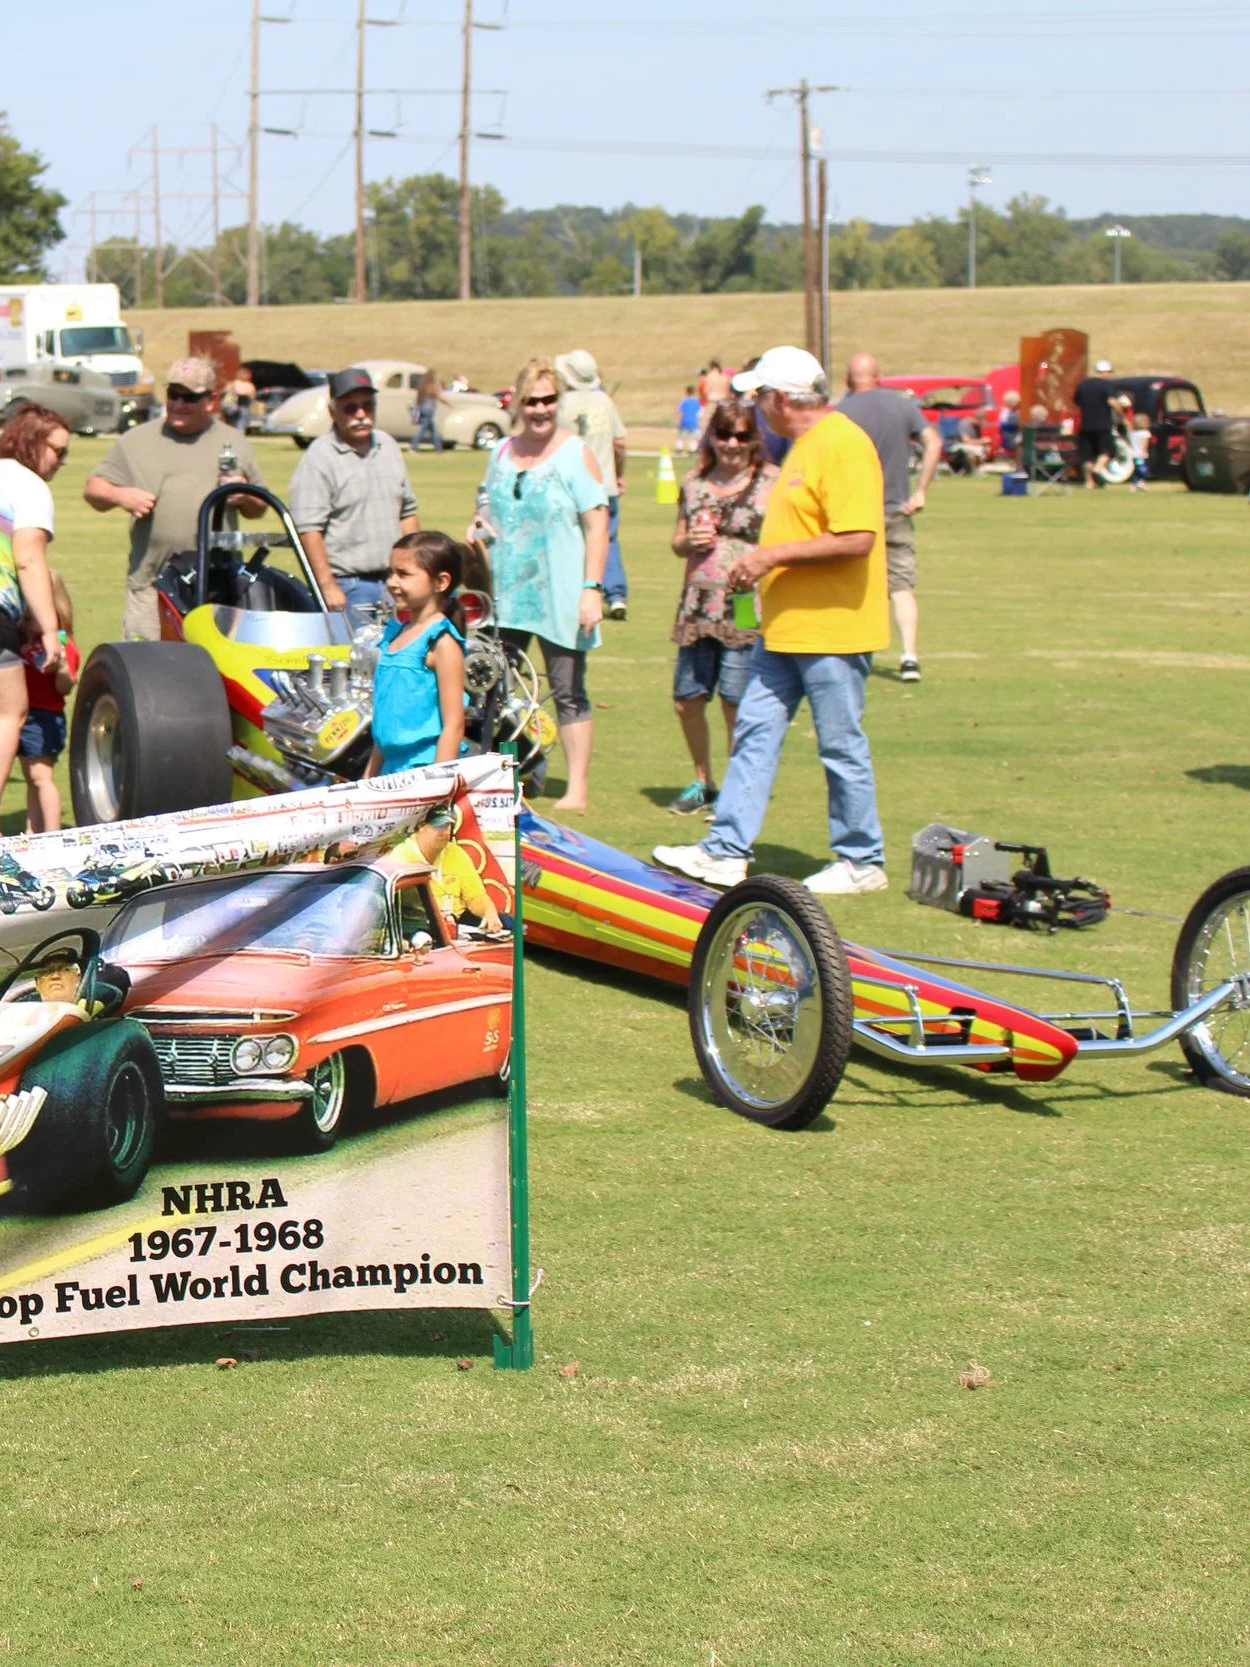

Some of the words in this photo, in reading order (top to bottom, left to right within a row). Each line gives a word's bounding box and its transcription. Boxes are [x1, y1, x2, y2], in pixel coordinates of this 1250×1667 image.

[160, 1177, 288, 1217] NHRA
[128, 1218, 325, 1263] 1967-1968
[54, 1274, 140, 1313] Fuel
[151, 1264, 269, 1308] World
[281, 1252, 484, 1297] Champion
